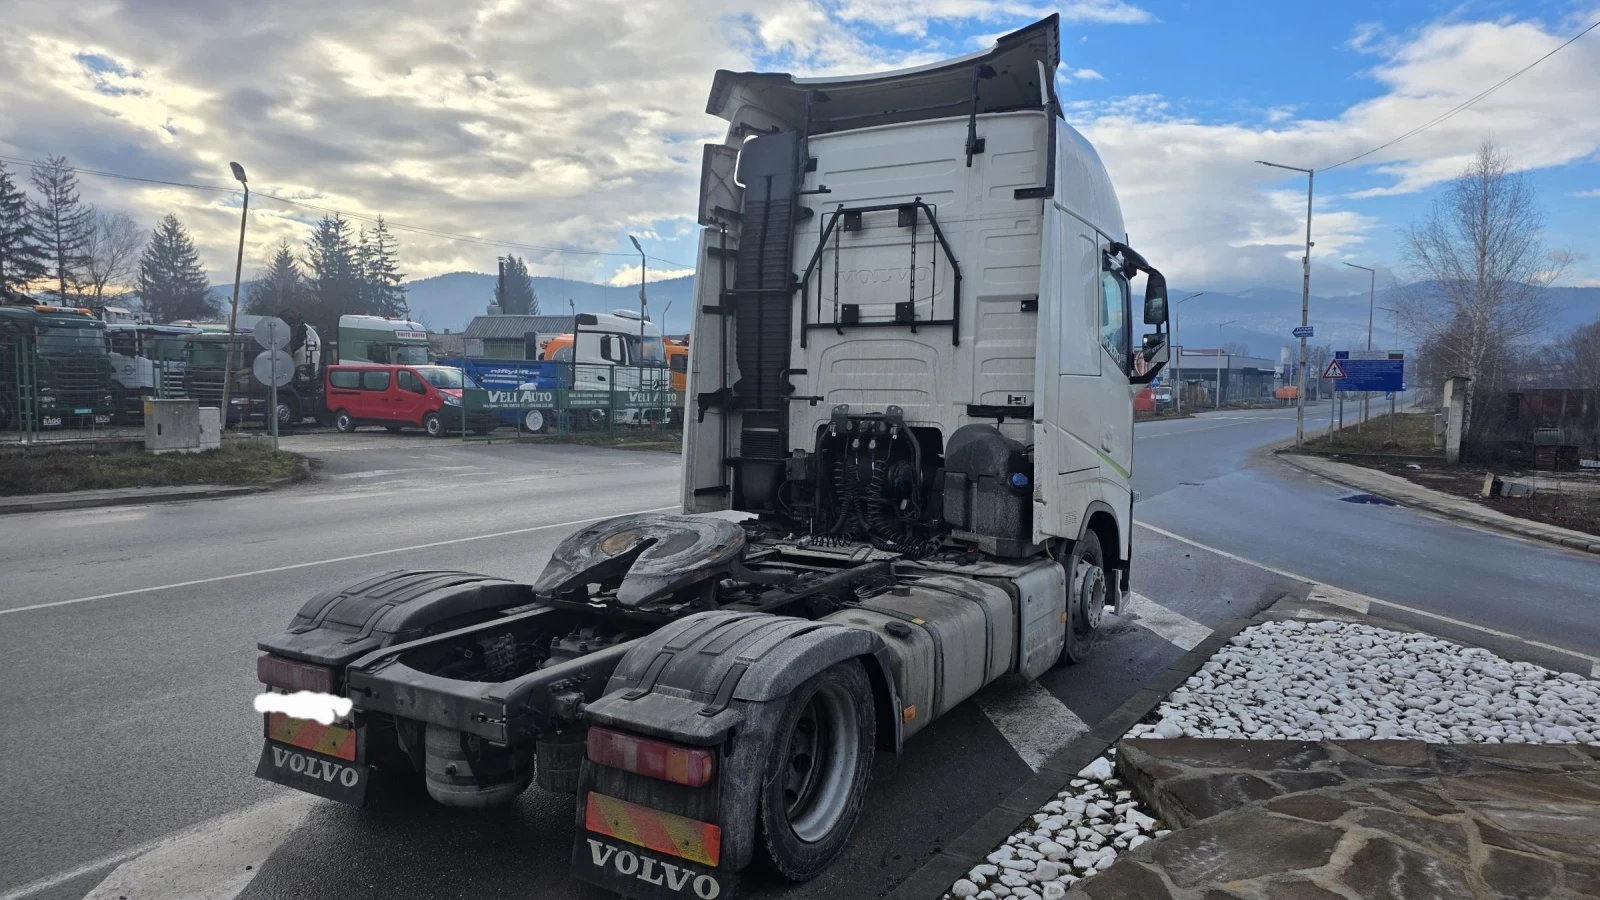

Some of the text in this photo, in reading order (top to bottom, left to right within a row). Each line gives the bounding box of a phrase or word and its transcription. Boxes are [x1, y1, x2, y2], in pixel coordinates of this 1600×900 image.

[838, 266, 932, 284] VOLVO
[487, 390, 552, 403] VELI AUTO
[628, 391, 650, 402] VELI
[271, 746, 359, 788] VOLVO
[586, 838, 721, 900] VOLVO
